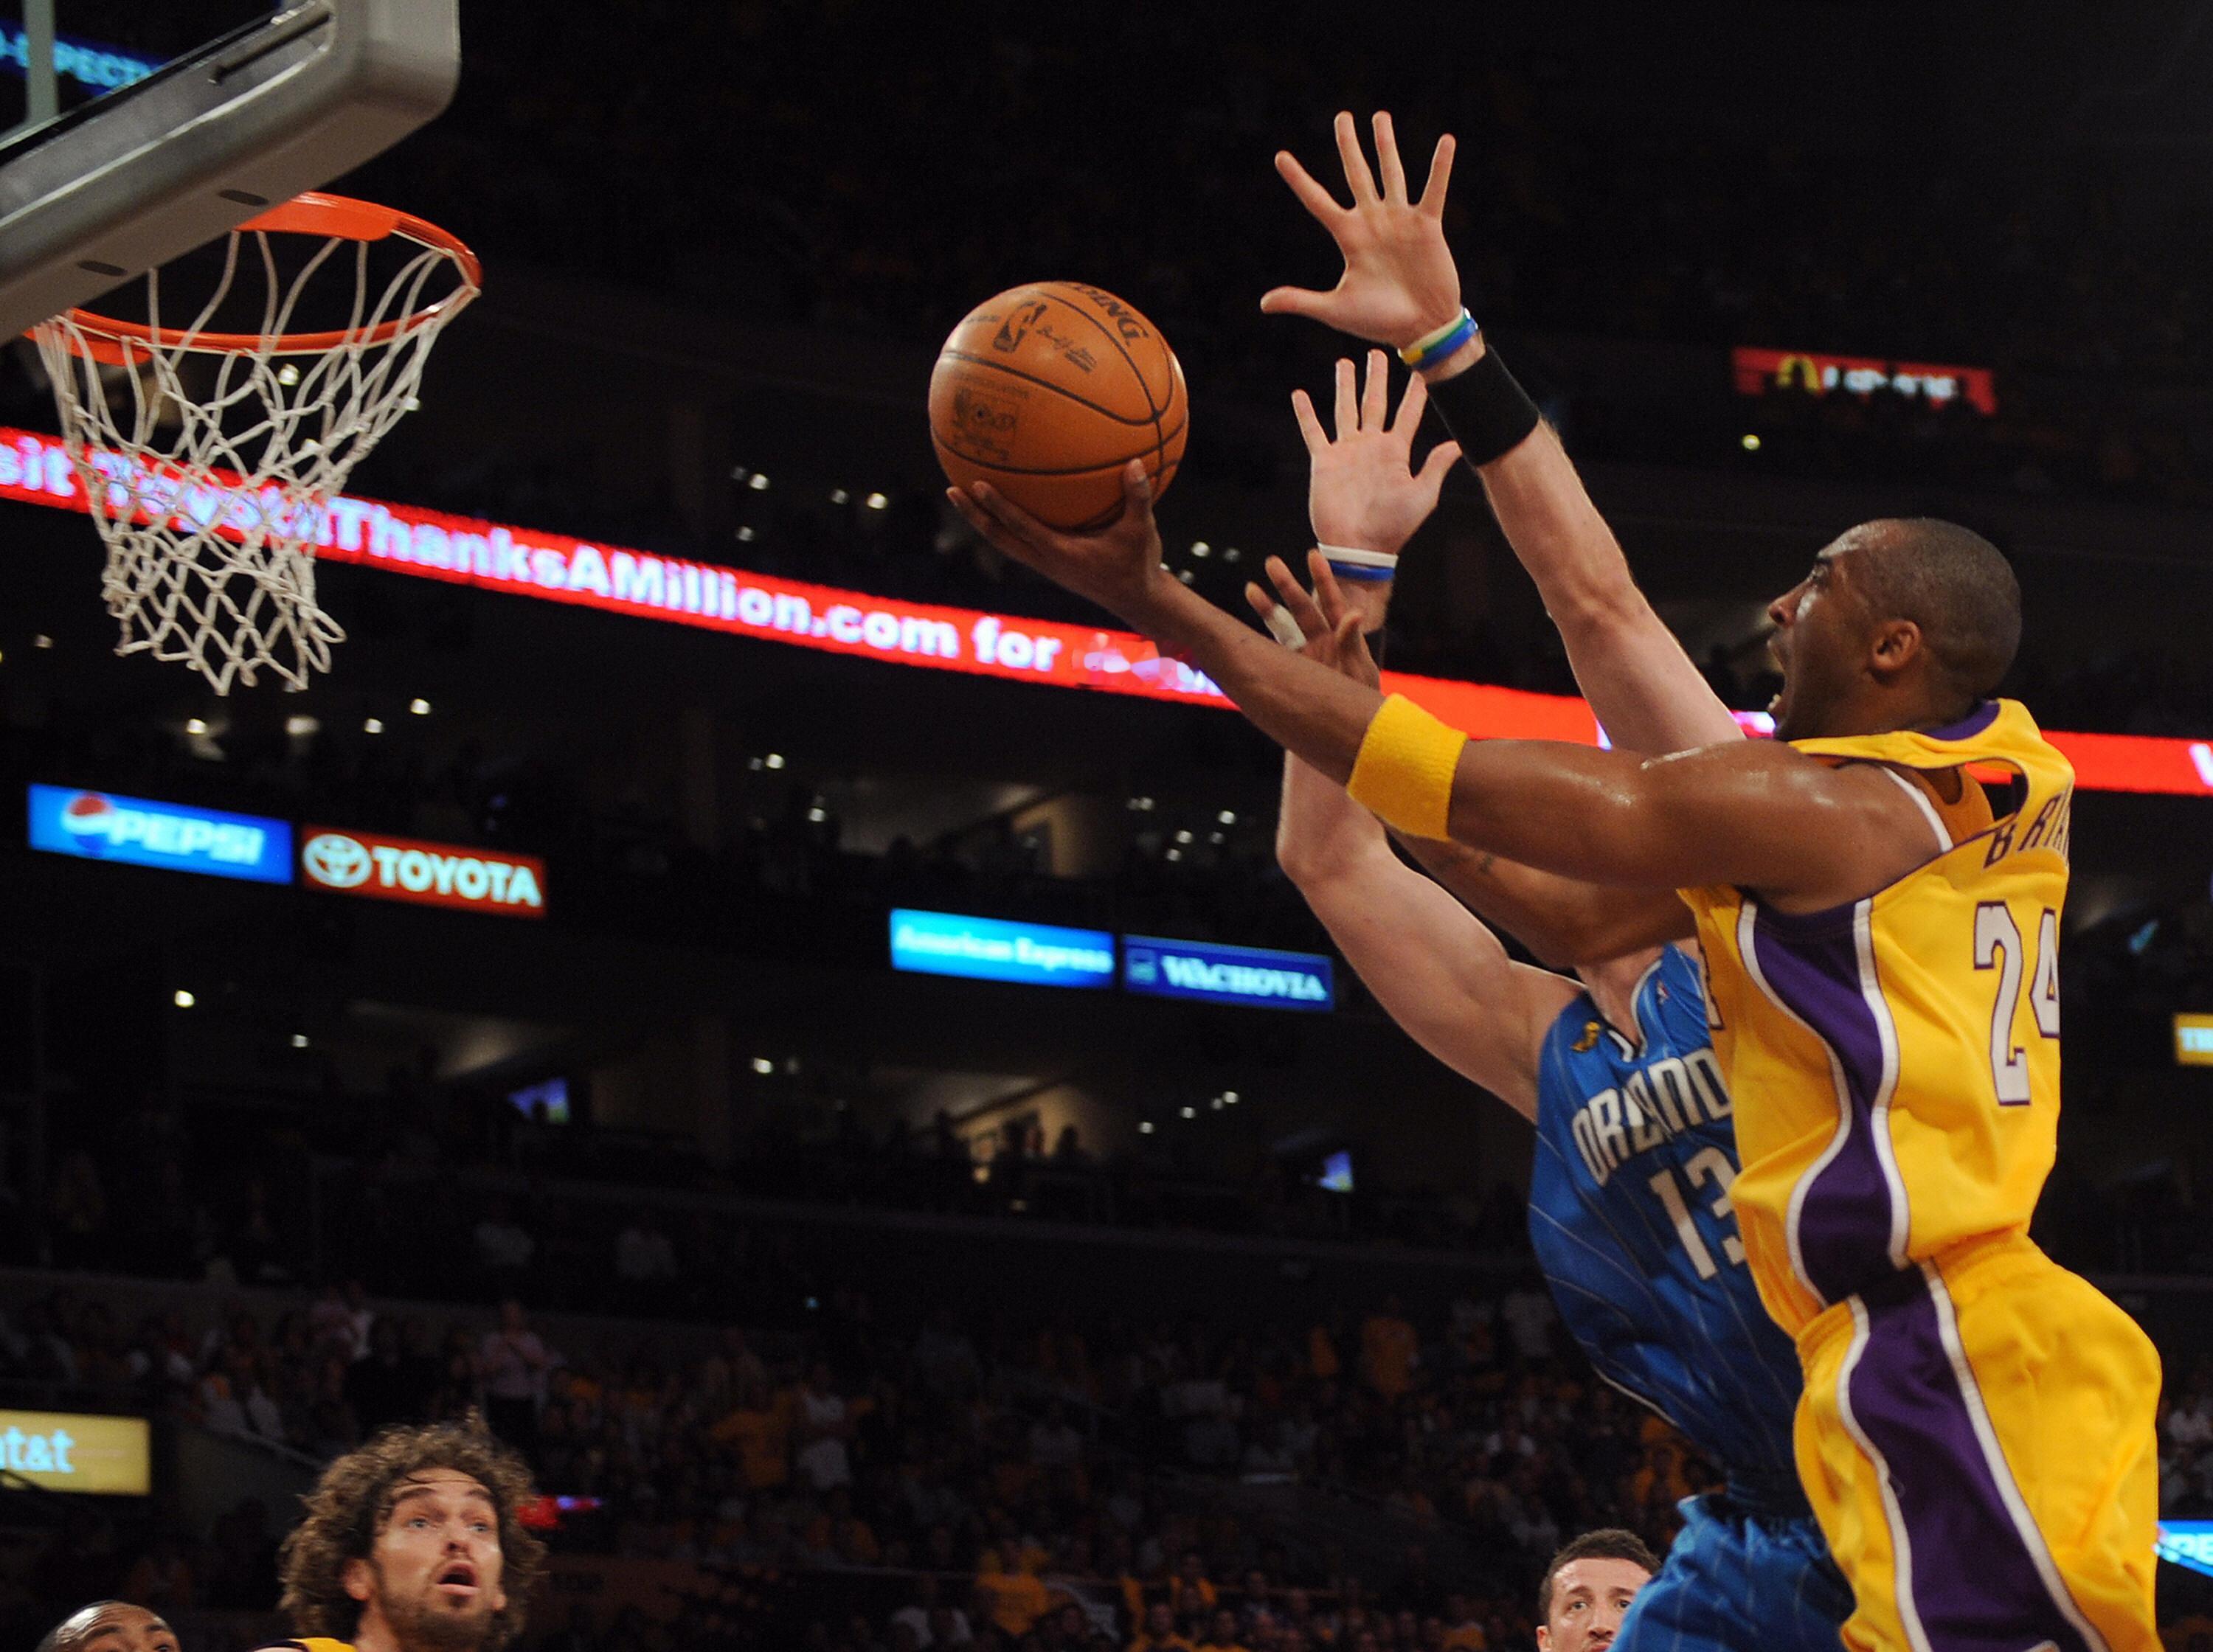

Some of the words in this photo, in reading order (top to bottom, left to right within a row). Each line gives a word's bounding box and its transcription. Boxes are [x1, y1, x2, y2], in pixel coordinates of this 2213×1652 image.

[972, 617, 1062, 673] for
[105, 808, 266, 867] PEPSI
[371, 845, 544, 908] TOYOTA
[1973, 900, 2063, 1107] 24
[1571, 1047, 1734, 1188] ORLAND
[1649, 1145, 1745, 1280] 13
